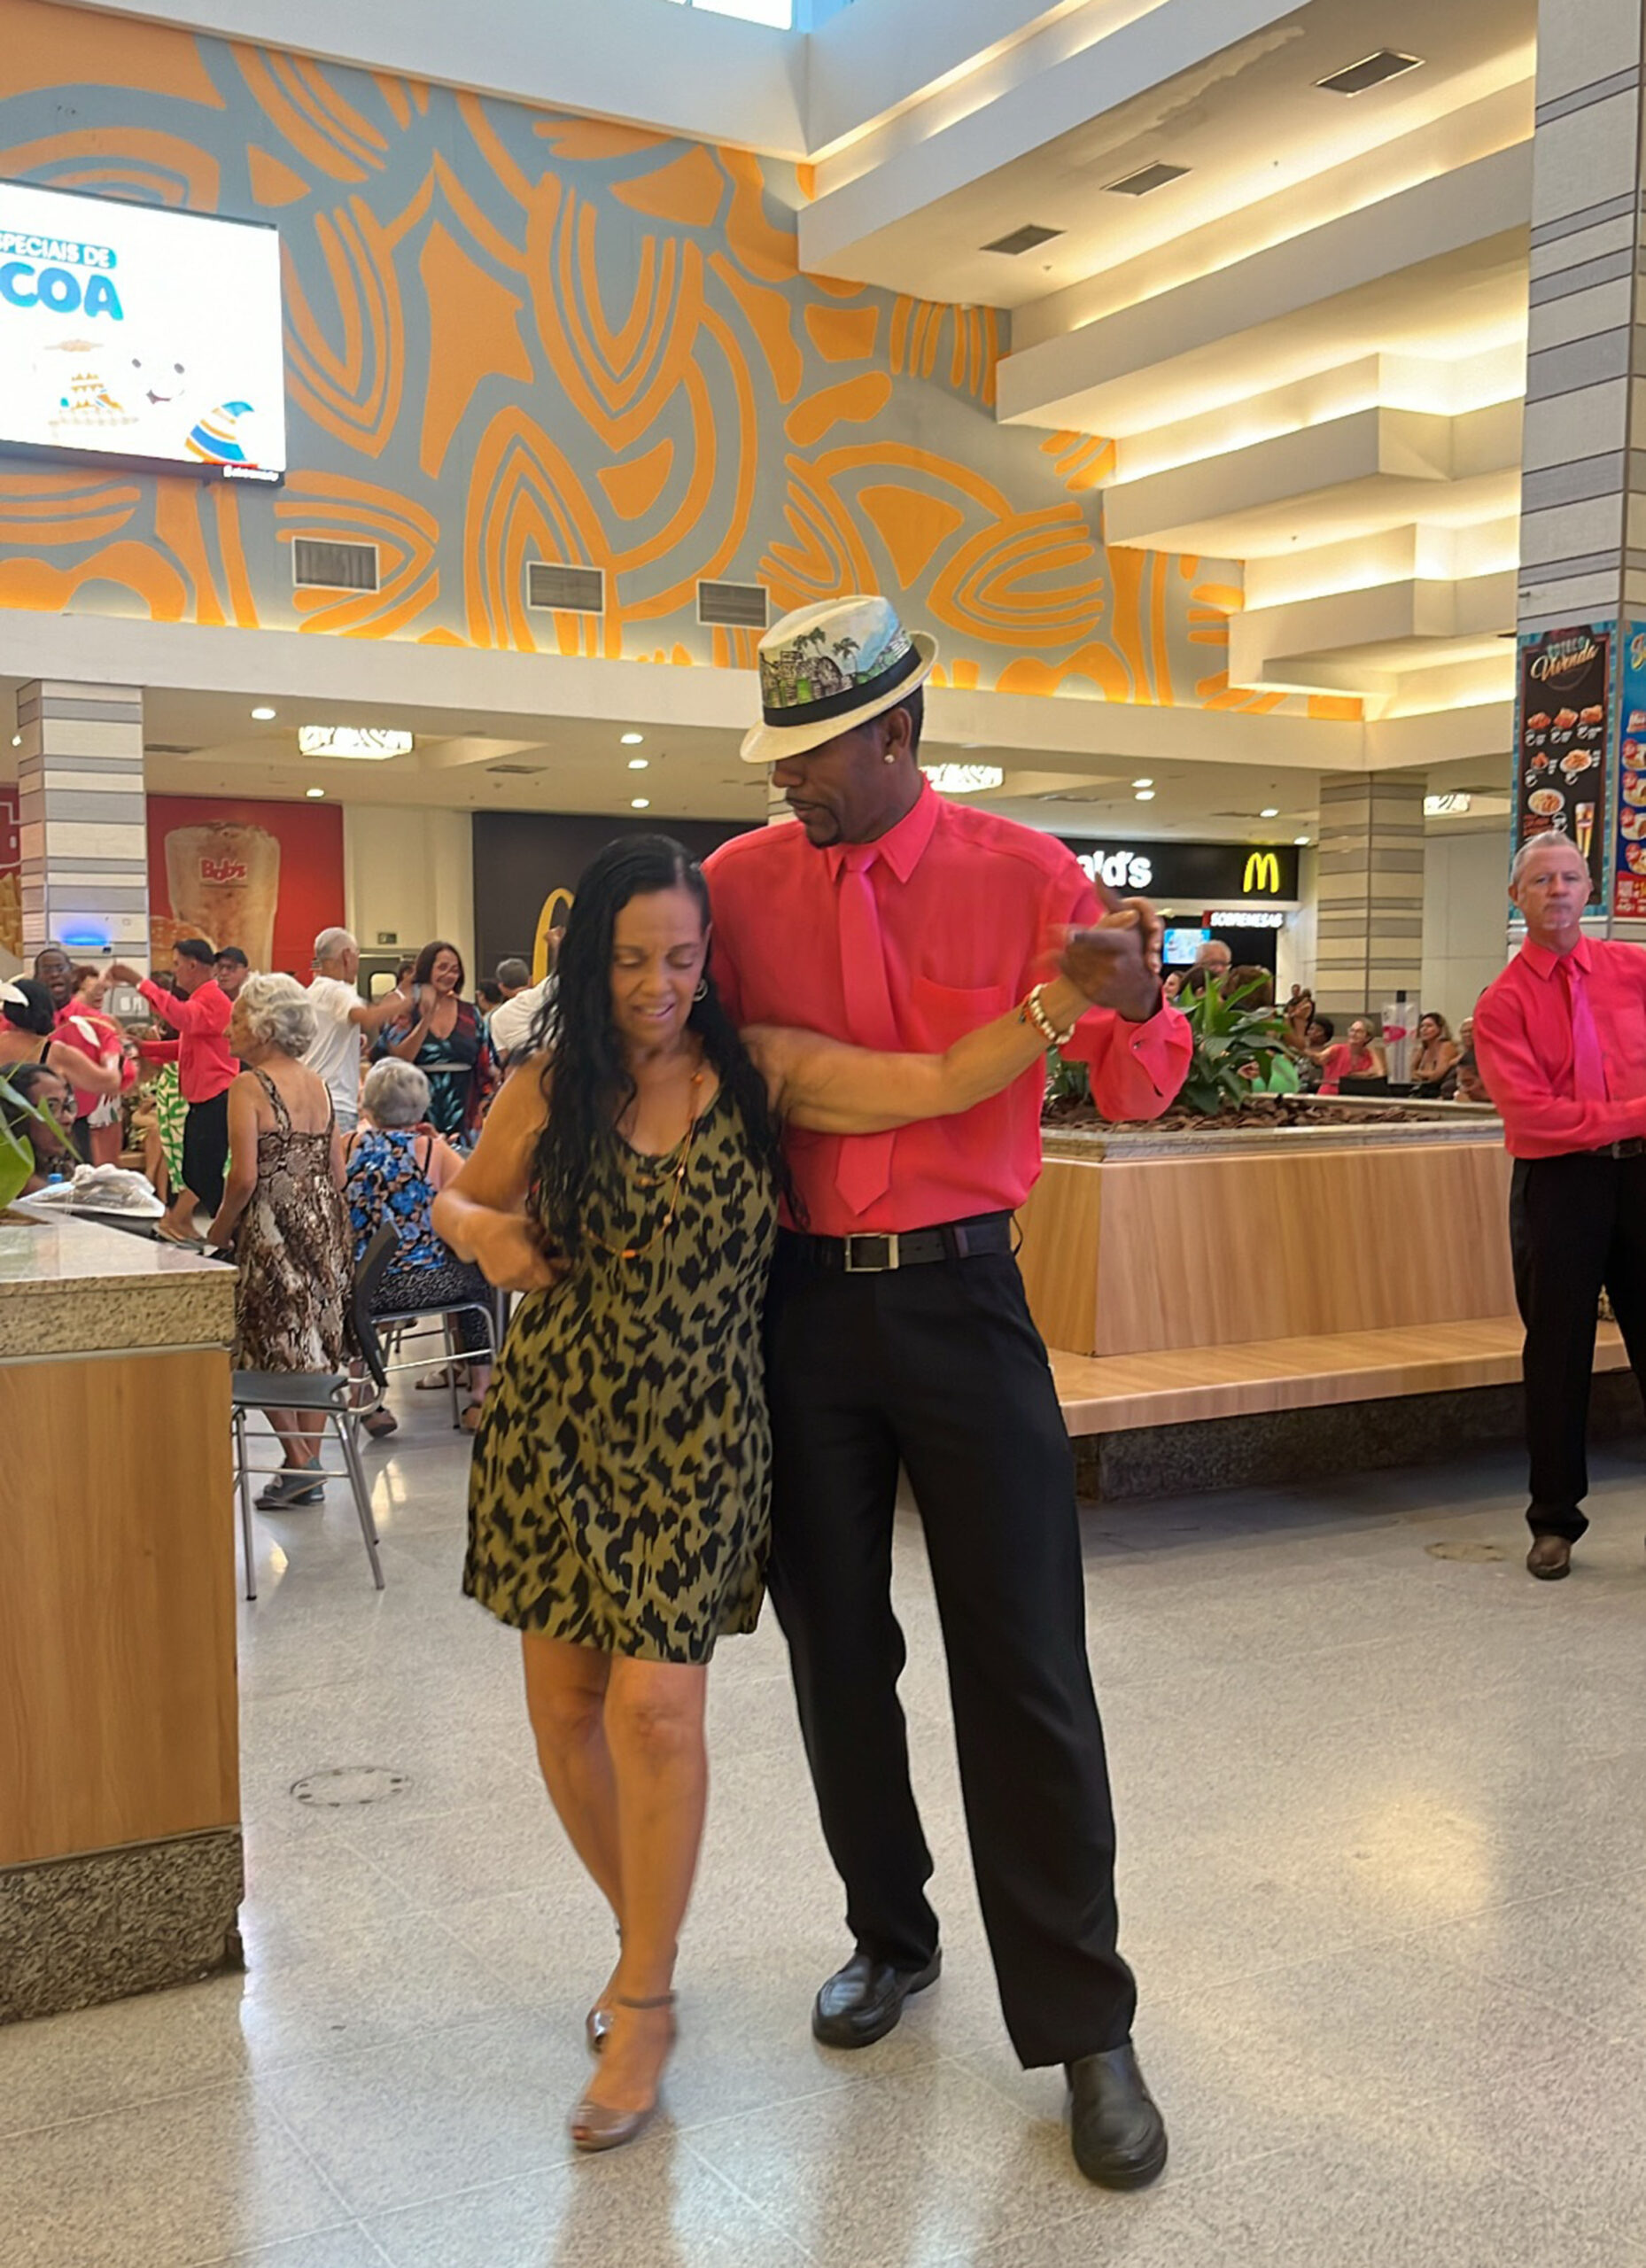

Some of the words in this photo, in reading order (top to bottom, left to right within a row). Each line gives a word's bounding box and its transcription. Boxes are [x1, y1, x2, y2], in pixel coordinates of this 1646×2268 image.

[83, 245, 110, 268] DE
[0, 261, 124, 321] COA
[200, 858, 247, 882] Bob's
